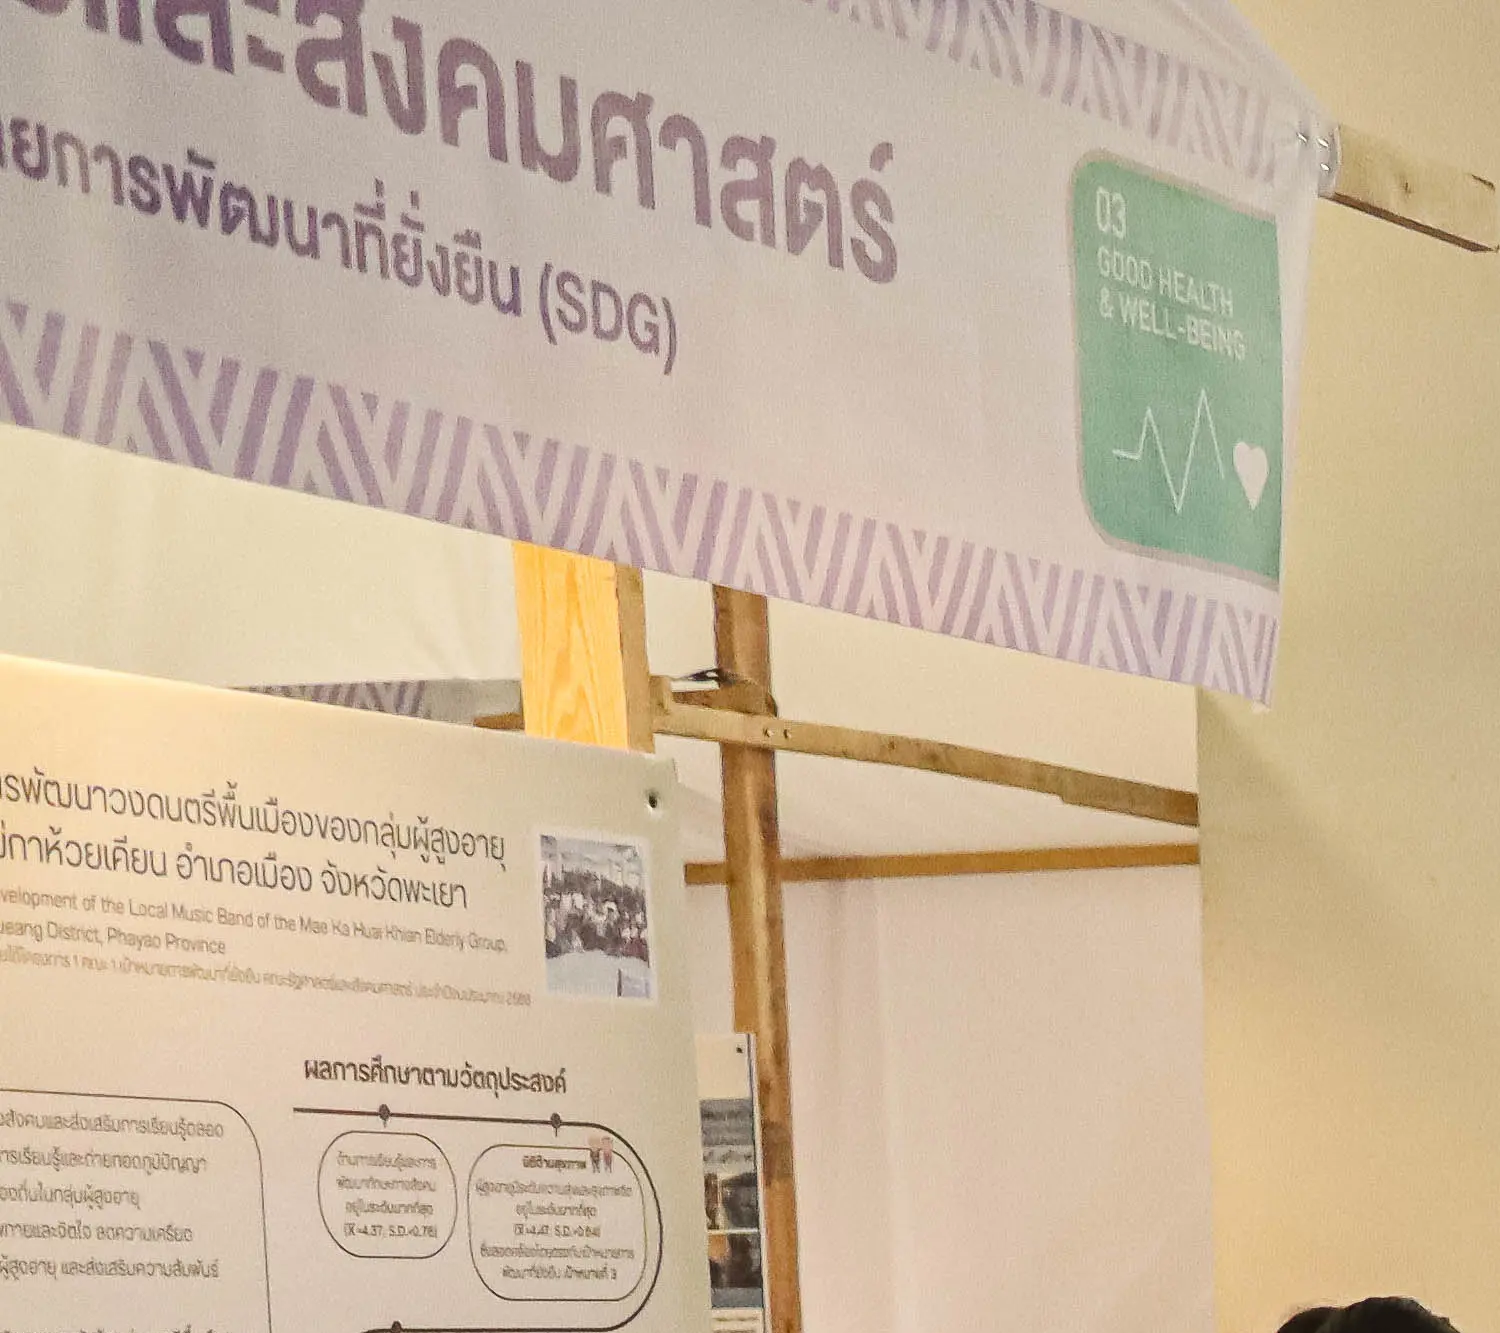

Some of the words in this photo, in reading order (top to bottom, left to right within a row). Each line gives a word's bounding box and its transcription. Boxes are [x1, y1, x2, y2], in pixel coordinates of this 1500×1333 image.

[1096, 185, 1127, 240] 03
[0, 117, 523, 317] ยการพัฒนาที่ยั่งยืน
[539, 262, 679, 375] (SDG)
[1098, 246, 1153, 291] GOOD
[1158, 266, 1235, 318] HEALTH
[1100, 287, 1115, 320] &
[1118, 291, 1247, 362] WELL-BEING
[0, 765, 507, 871] รพัฒนาวงดนตรีพื้นเมืองของกลุ่มผู้สูงอายุ
[176, 842, 313, 892] อำเภอเมือง
[321, 860, 468, 909] จังหวัดพะเยา
[47, 920, 103, 947] District,
[107, 927, 161, 951] Phayao
[165, 932, 226, 955] Province
[82, 893, 97, 906] of
[101, 893, 125, 915] the
[128, 896, 168, 919] Local
[172, 902, 213, 923] Music
[217, 906, 253, 927] Band
[257, 911, 271, 928] of
[303, 1054, 568, 1098] ผลการศึกษาตามวัตถุประสงค์
[0, 1108, 225, 1141] สังคมและส่งเสริมการเรียนรู้ตลอด
